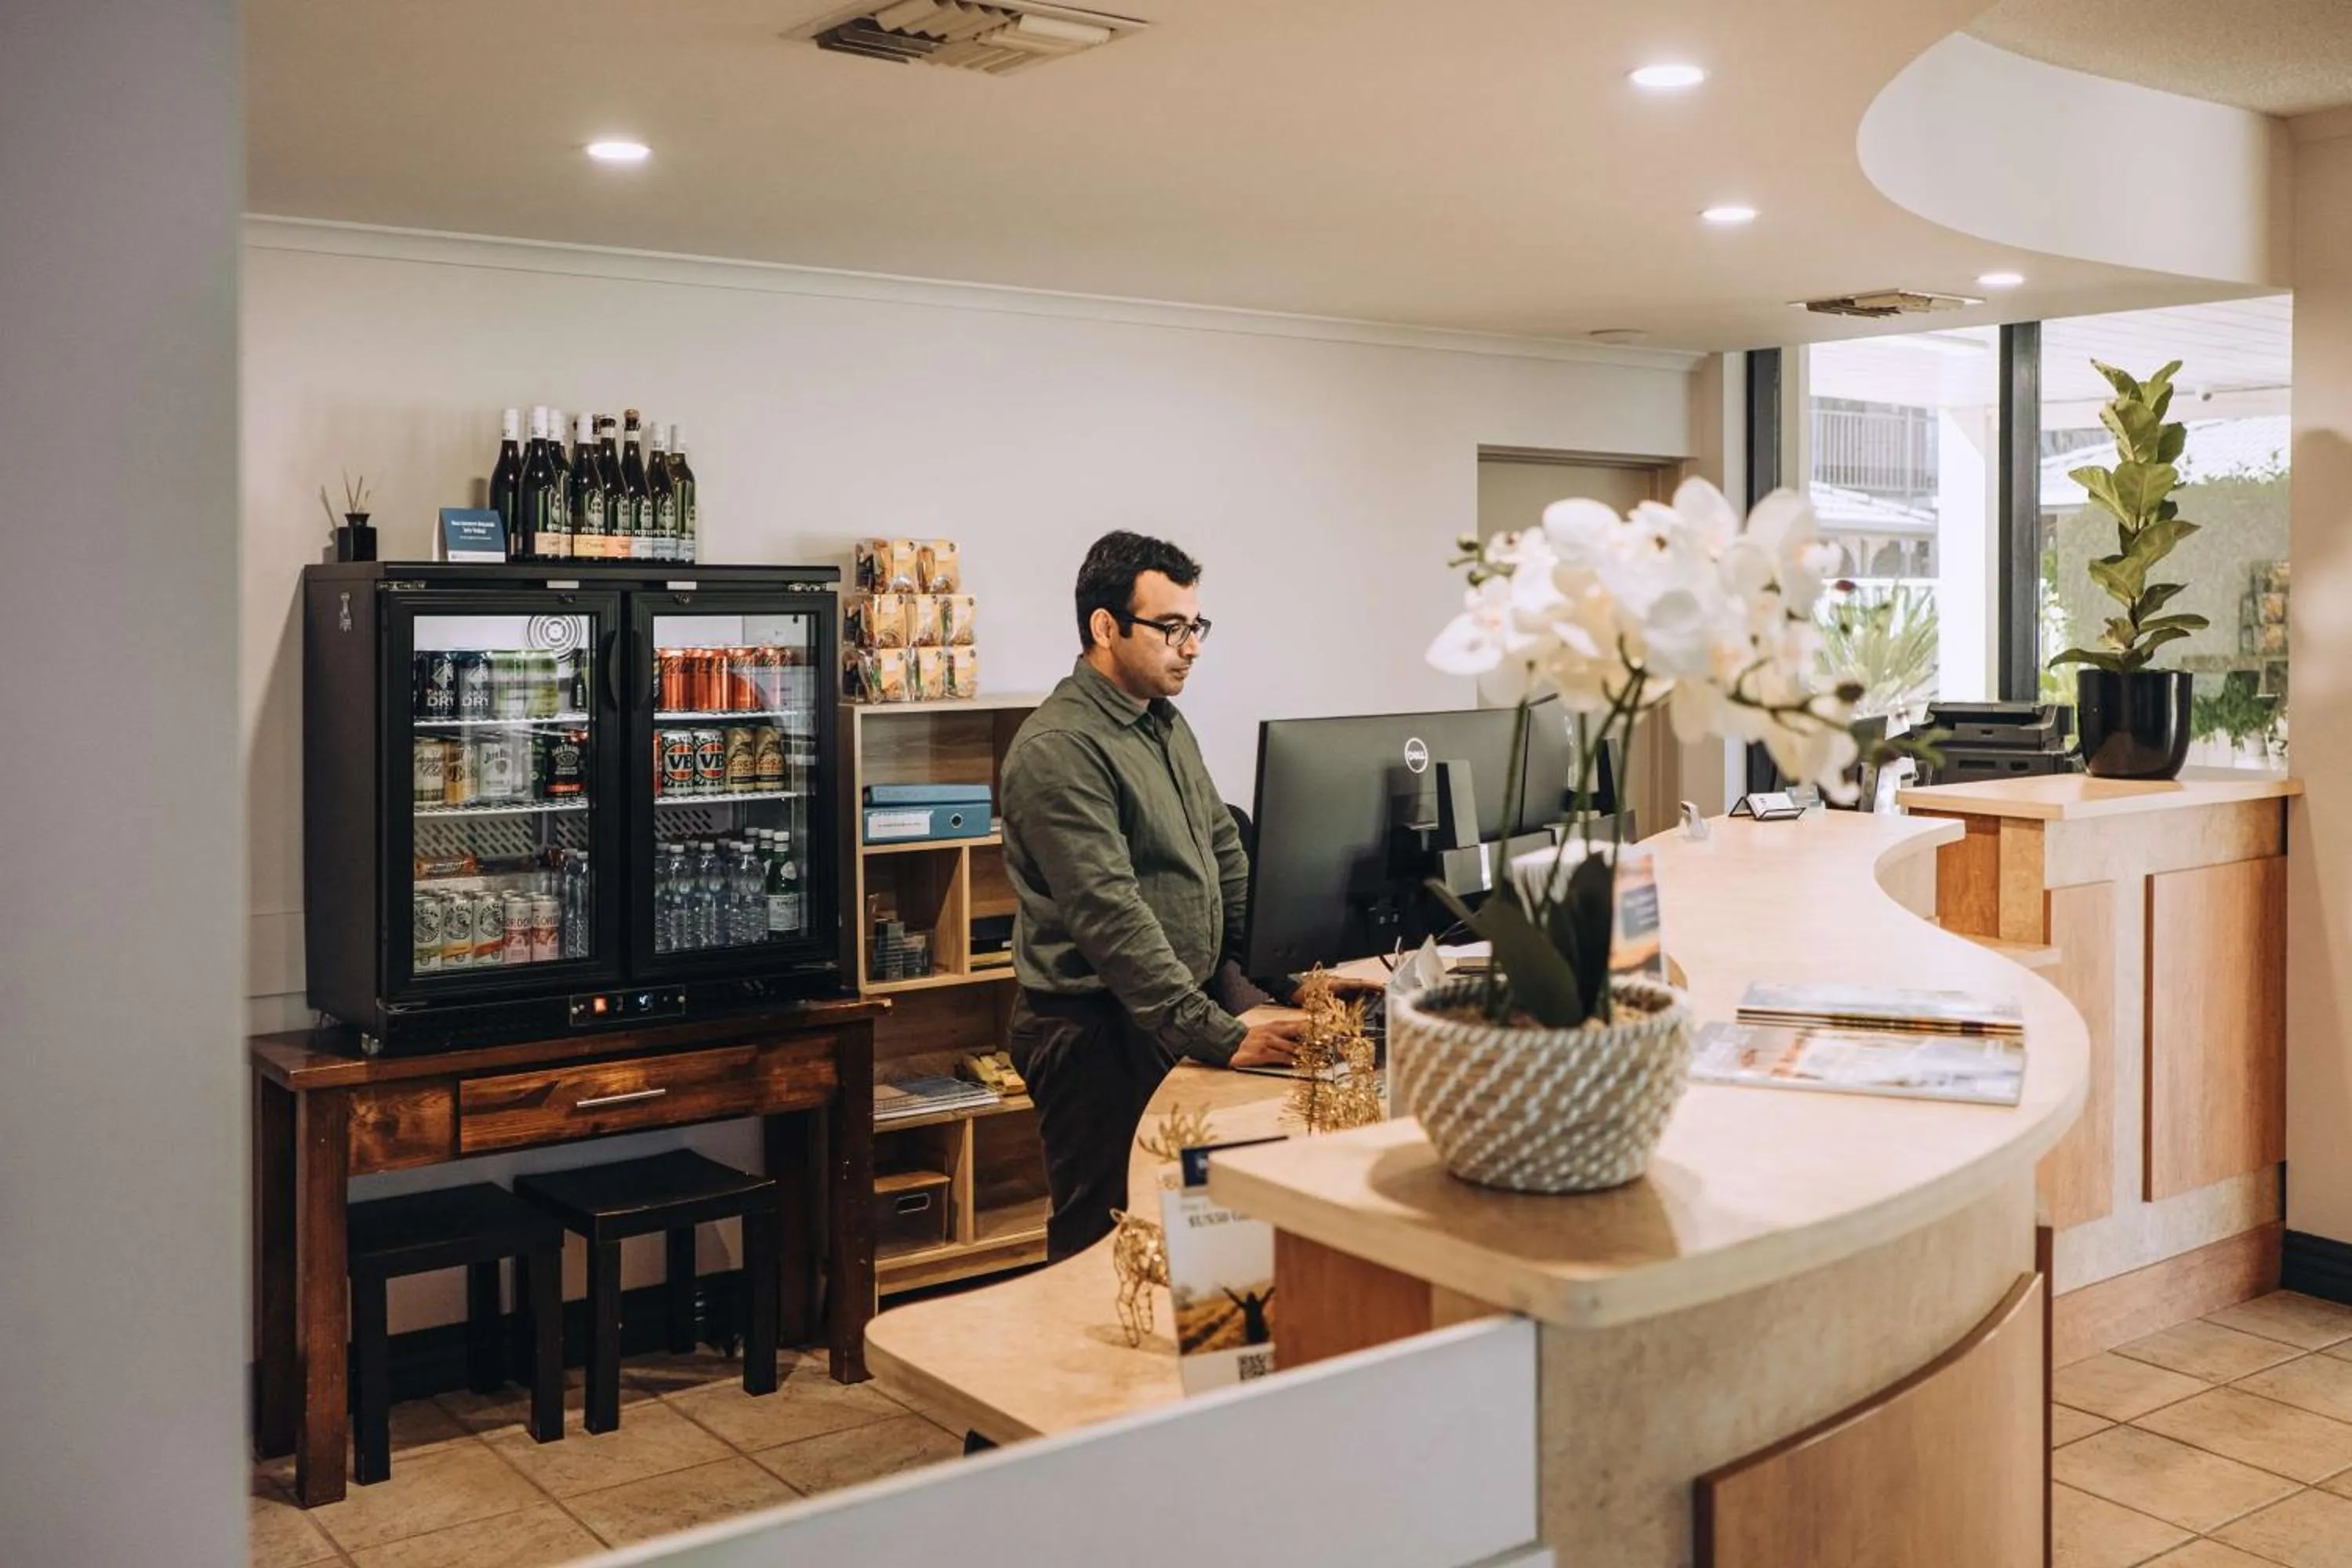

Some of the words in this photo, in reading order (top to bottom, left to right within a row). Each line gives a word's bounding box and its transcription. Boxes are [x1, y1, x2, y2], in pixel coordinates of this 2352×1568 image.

[427, 696, 454, 706] DRY
[461, 696, 488, 706] DRY
[1407, 750, 1425, 760] DELL
[668, 754, 693, 769] VB
[700, 754, 724, 769] VB
